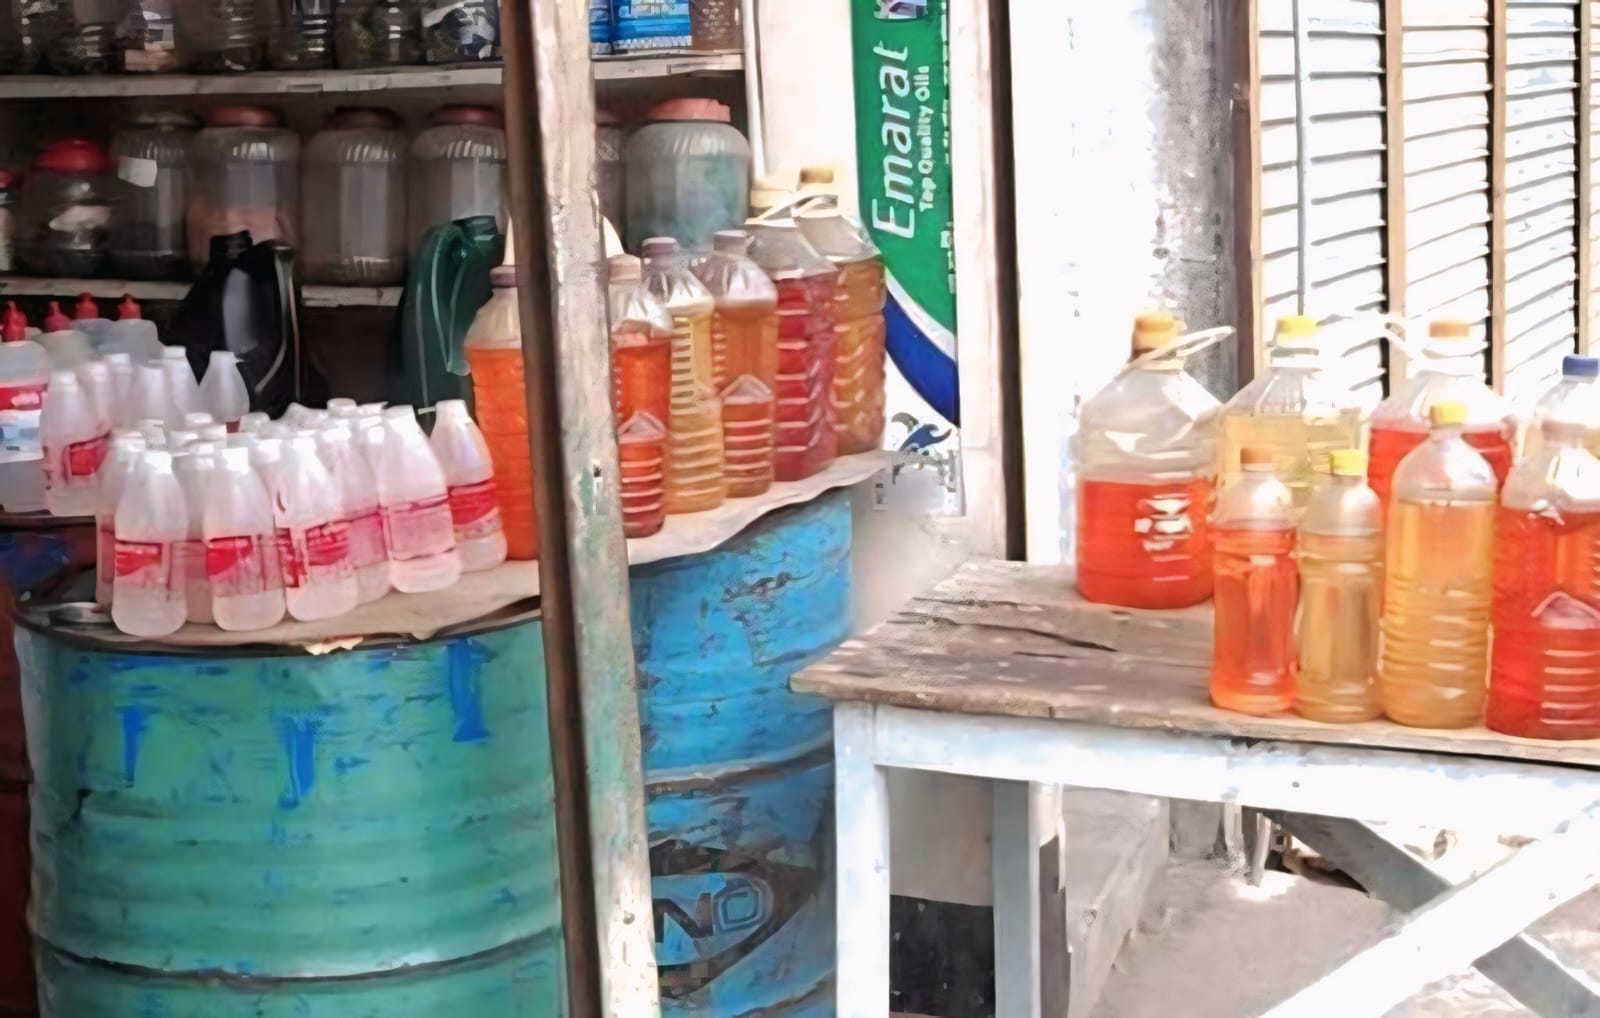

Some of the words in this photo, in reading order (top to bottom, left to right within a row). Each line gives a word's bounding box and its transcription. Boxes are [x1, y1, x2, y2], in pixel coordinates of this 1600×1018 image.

[872, 40, 916, 239] Emarat
[917, 105, 935, 175] Quality
[919, 177, 937, 213] Top
